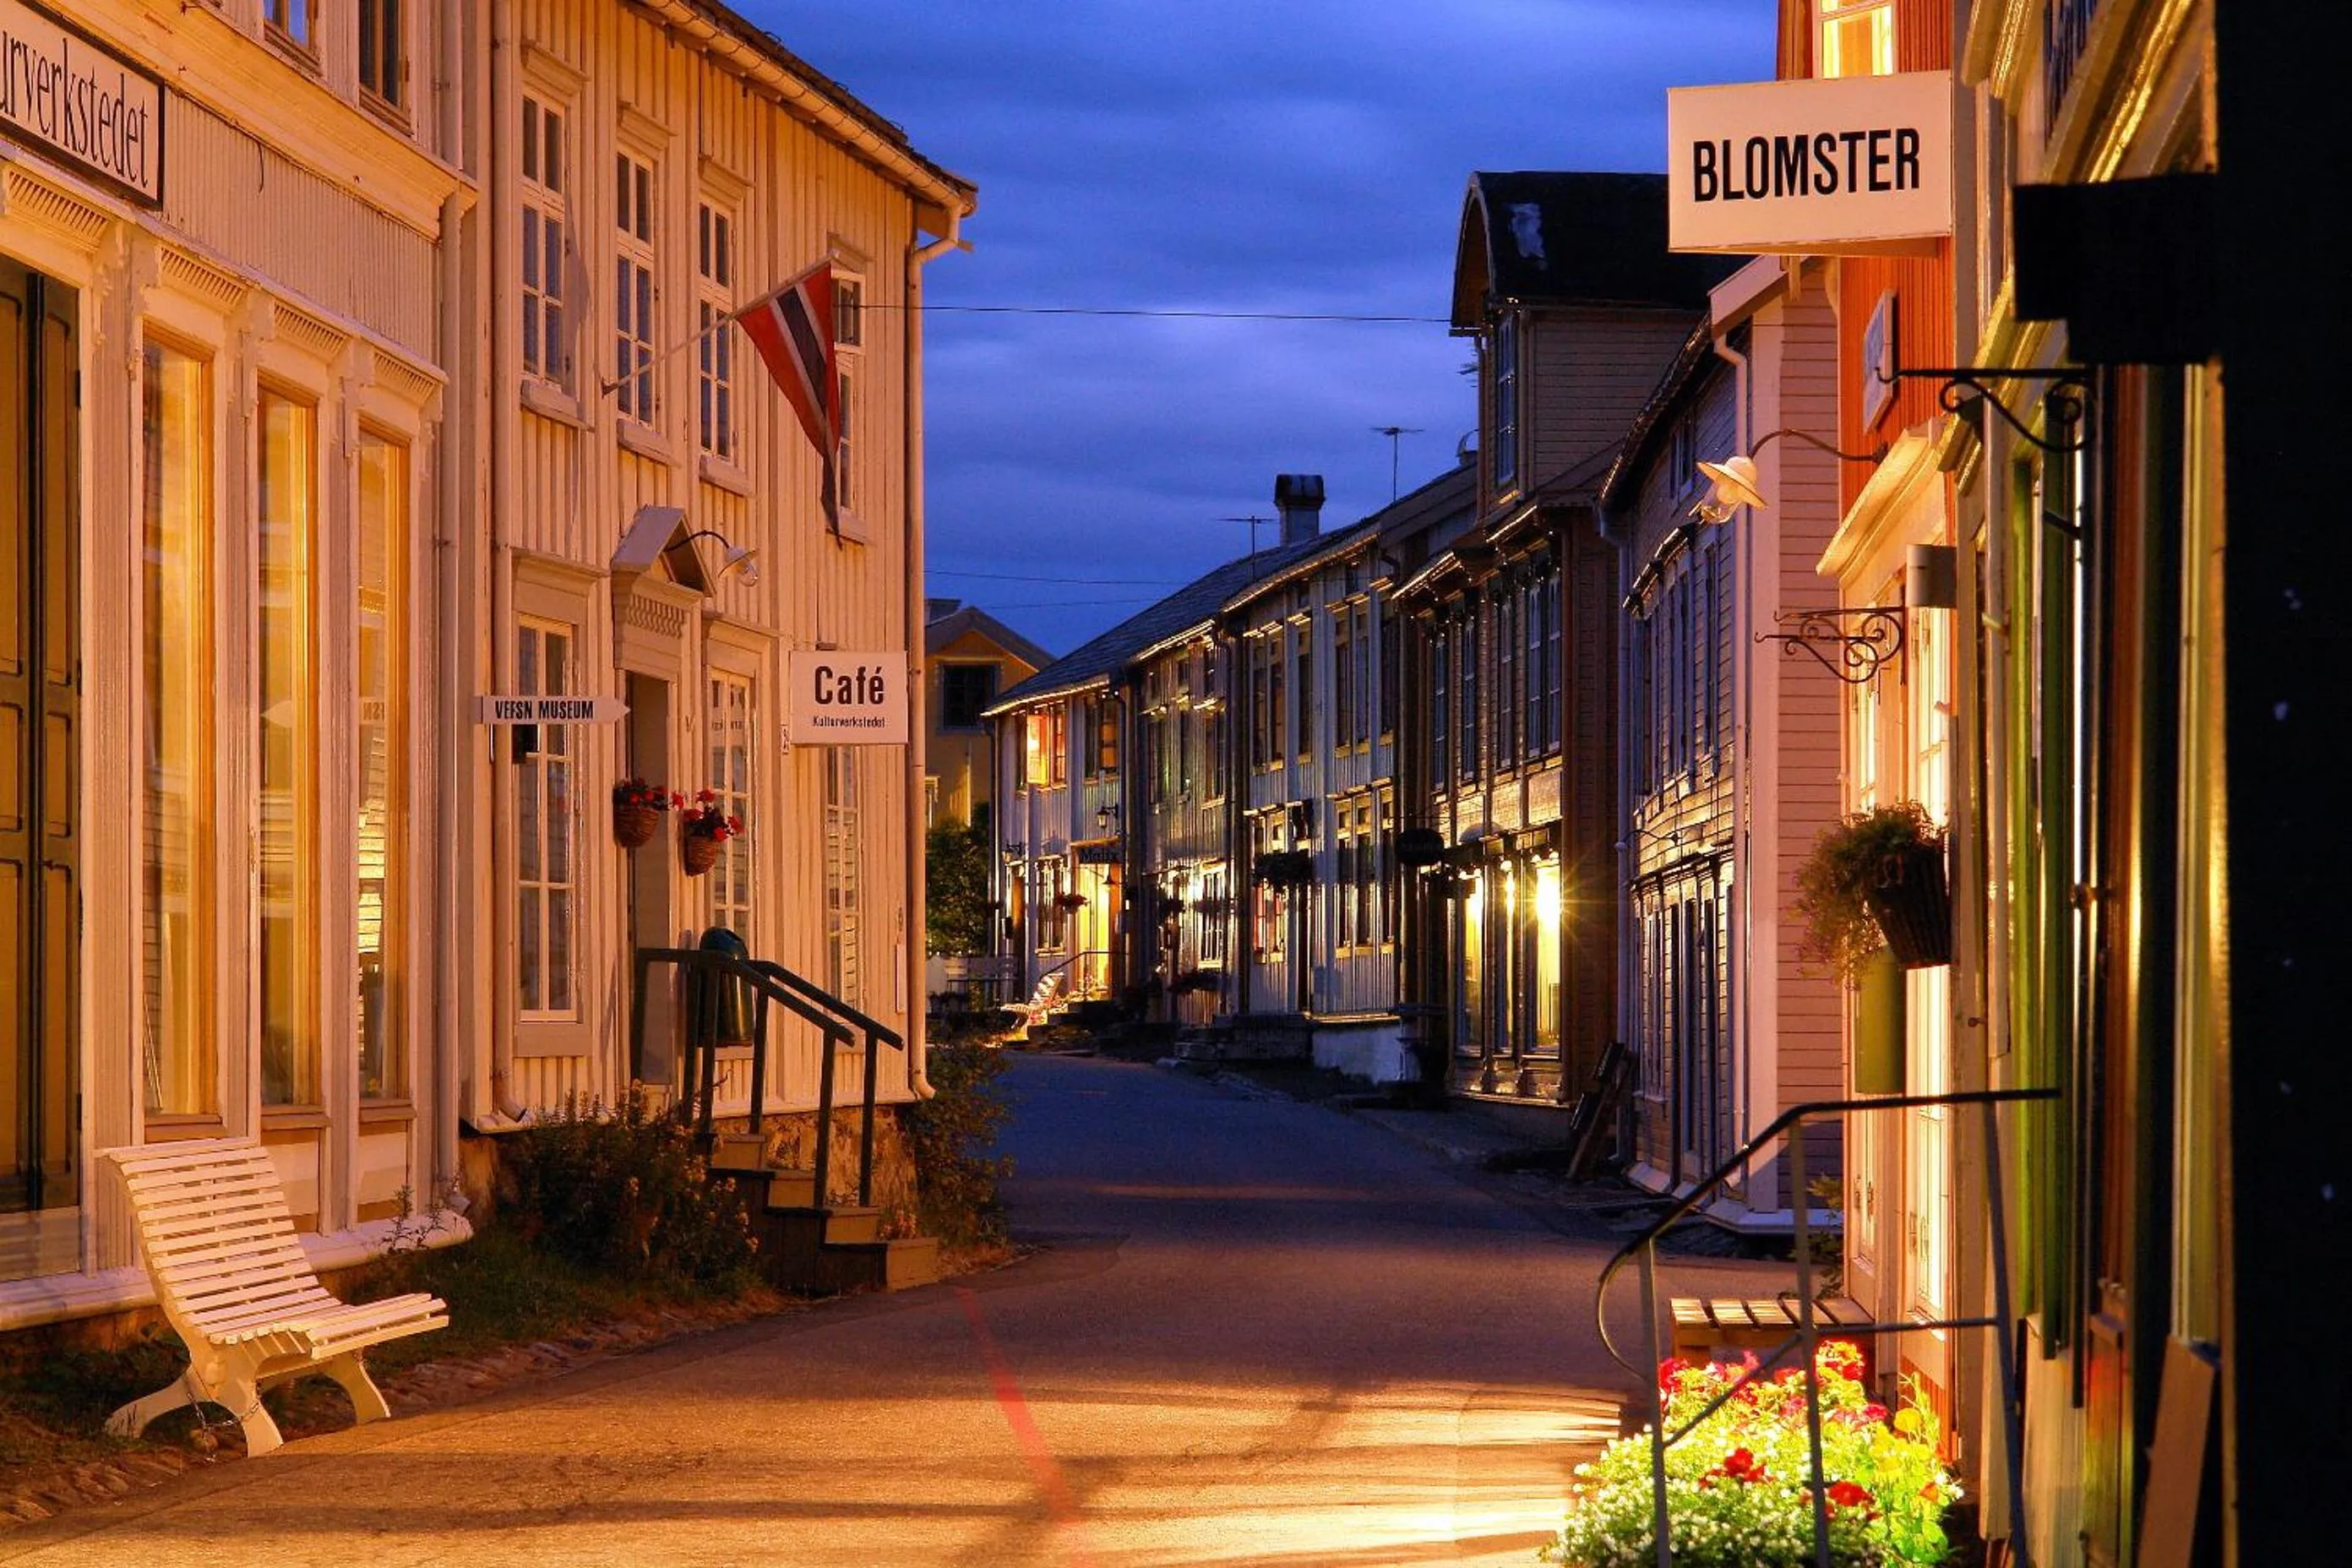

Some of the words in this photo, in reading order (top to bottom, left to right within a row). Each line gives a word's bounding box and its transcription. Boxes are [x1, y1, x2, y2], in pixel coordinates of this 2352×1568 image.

[1693, 128, 1920, 202] BLOMSTER
[814, 666, 884, 705] Café
[495, 700, 532, 720] VEFSN
[538, 700, 594, 720] MUSEUM
[813, 716, 885, 727] Kulturverkstedet
